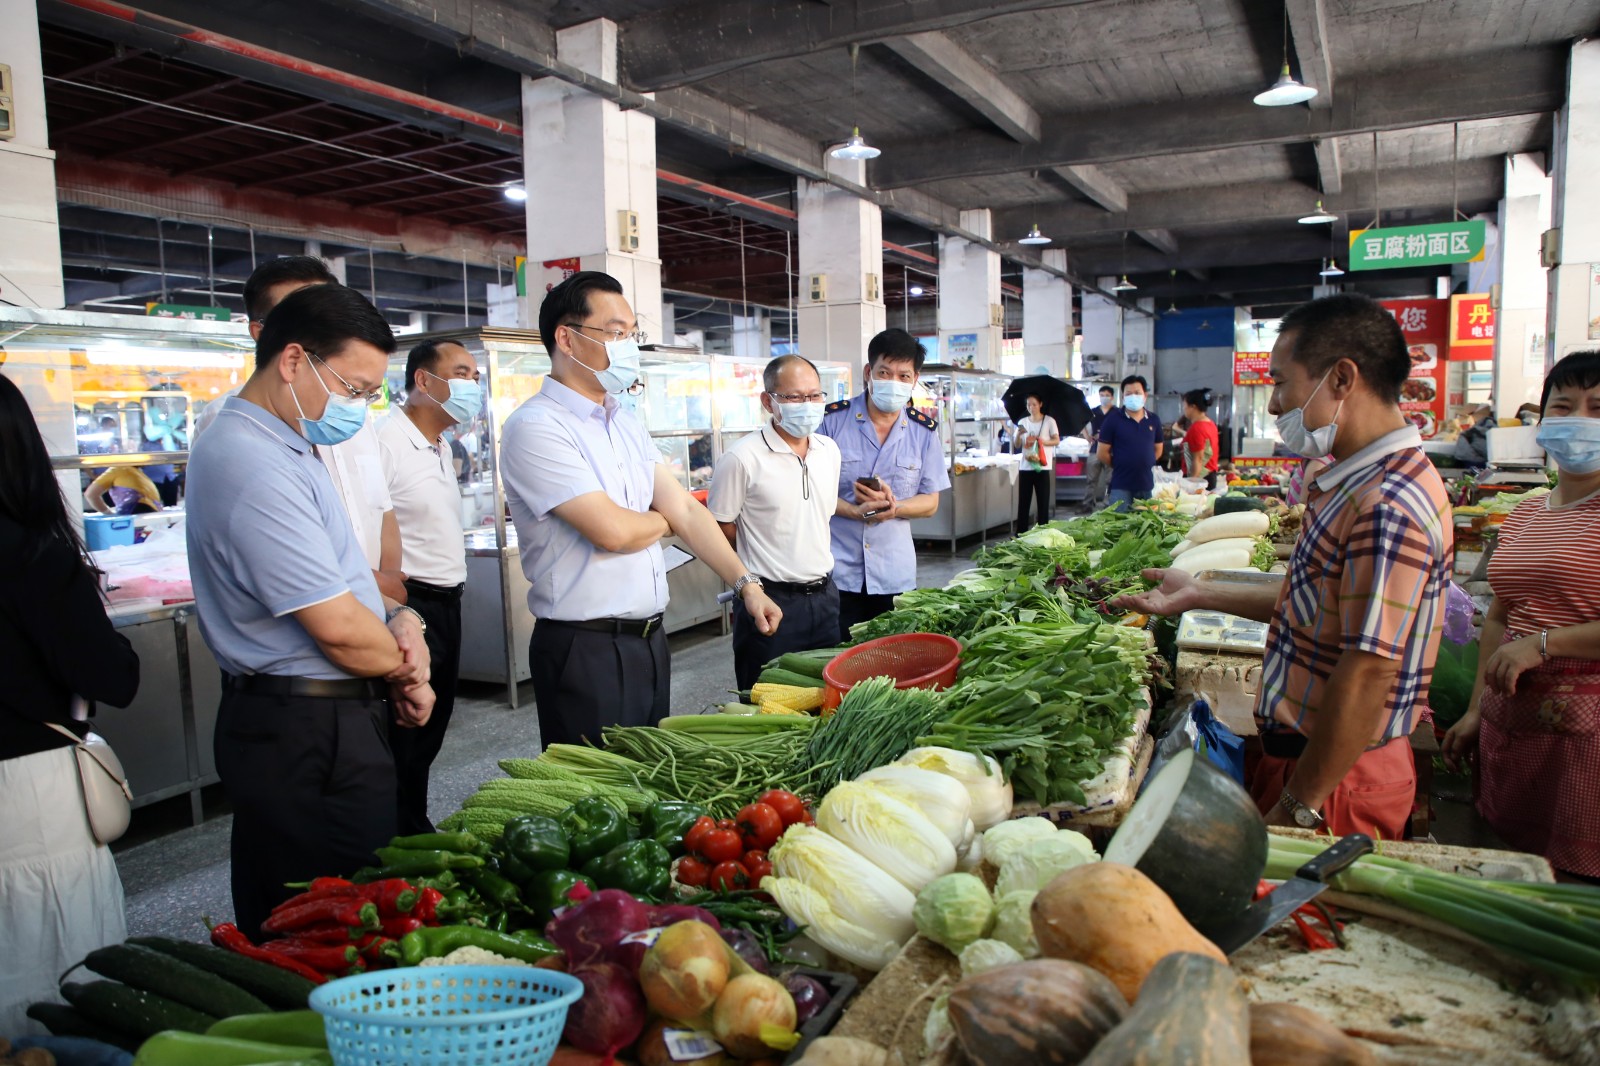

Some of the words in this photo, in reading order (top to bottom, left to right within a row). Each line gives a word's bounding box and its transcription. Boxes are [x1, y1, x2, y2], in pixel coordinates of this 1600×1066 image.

[1363, 231, 1471, 260] 豆腐粉面区
[1468, 304, 1491, 324] 丹
